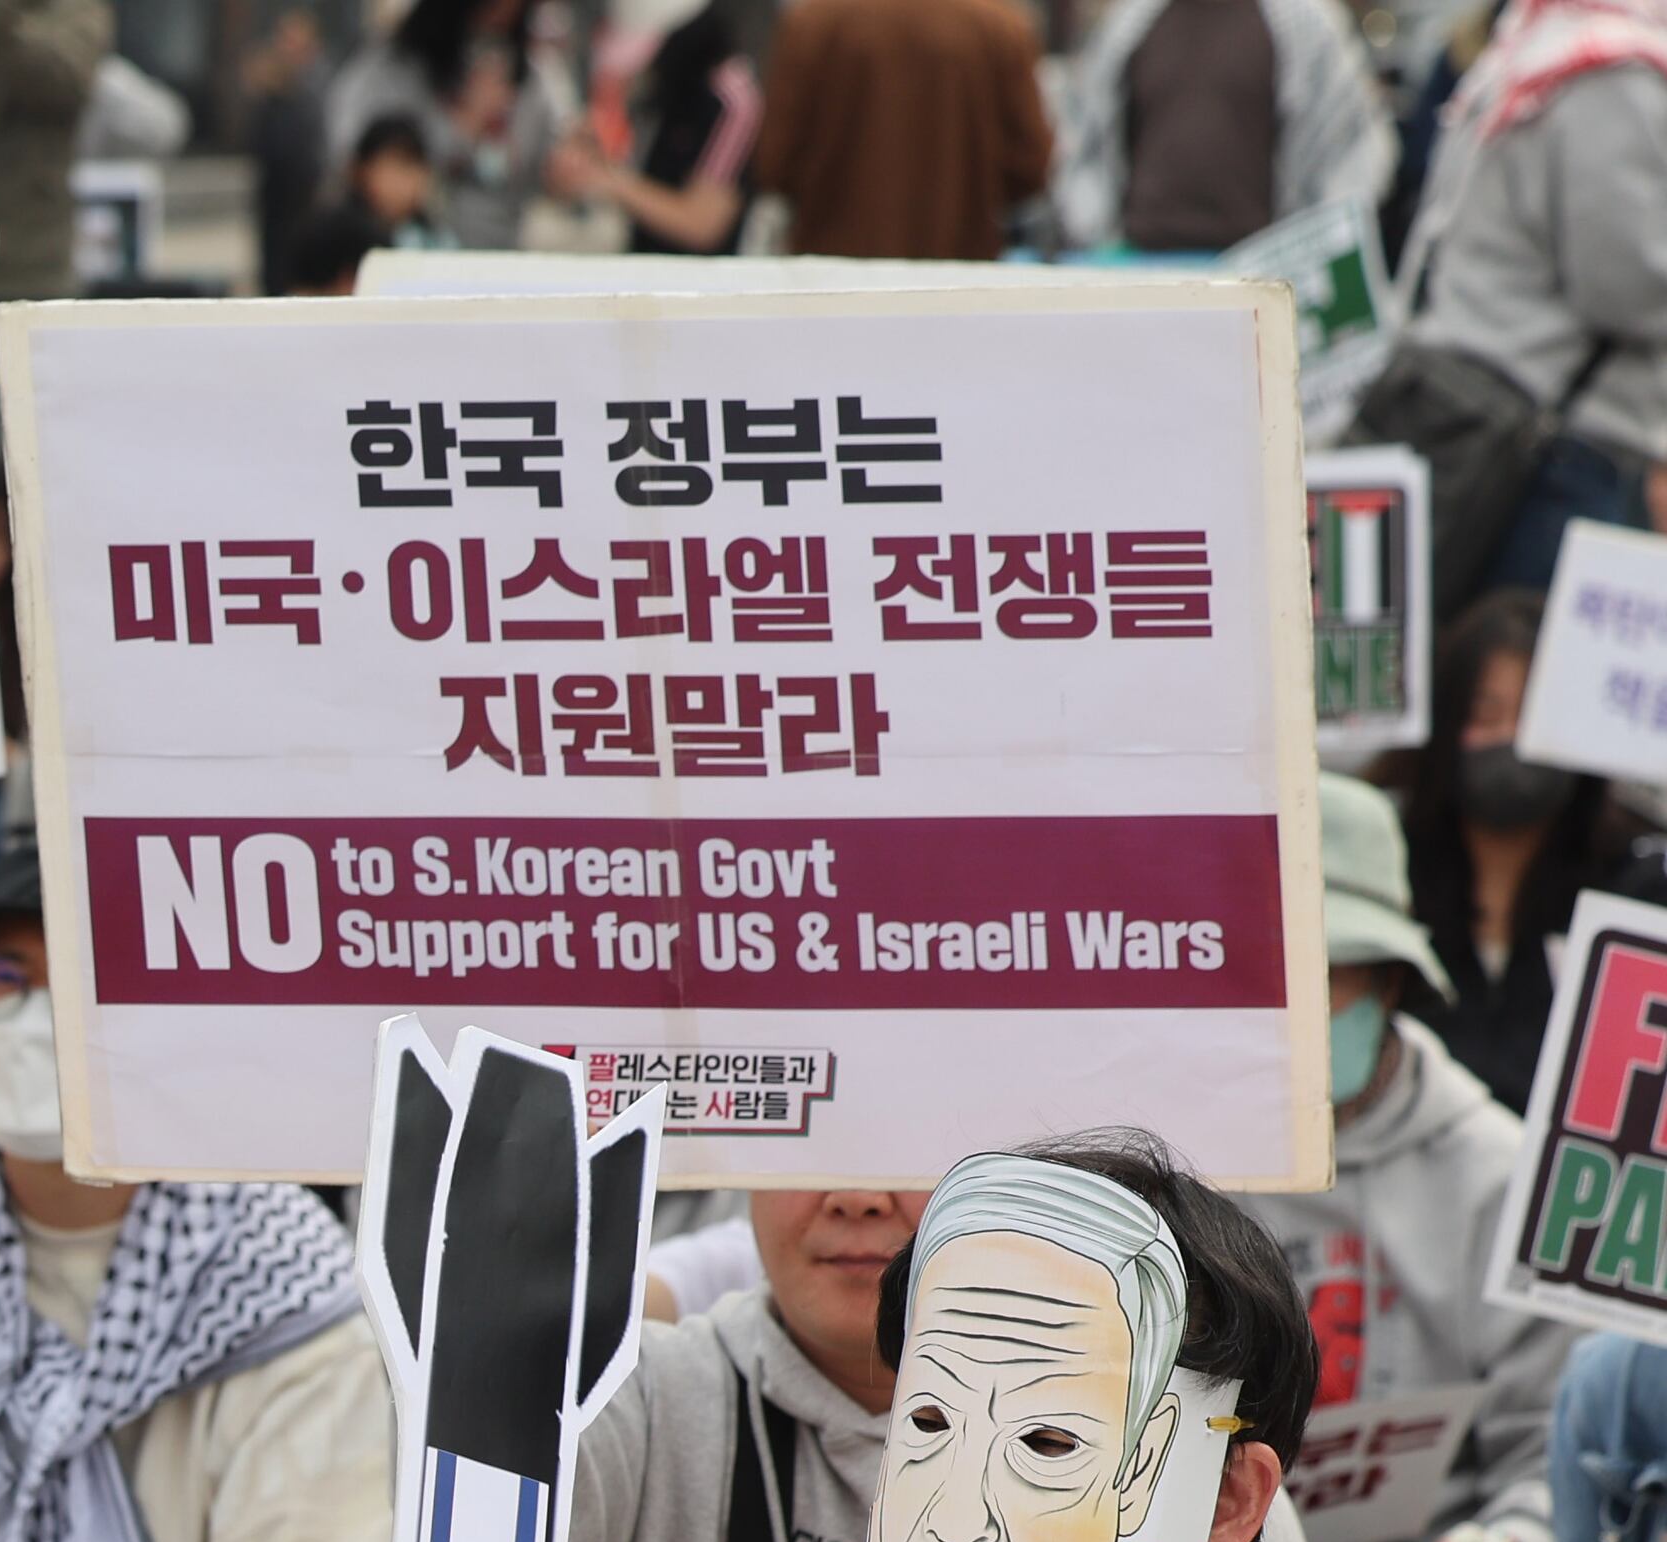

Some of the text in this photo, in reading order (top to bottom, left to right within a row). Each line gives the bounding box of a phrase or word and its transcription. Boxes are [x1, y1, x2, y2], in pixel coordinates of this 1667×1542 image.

[347, 397, 942, 507] 한국 정부는
[108, 531, 1212, 644] 미국·이스라엘 전쟁들
[440, 673, 889, 777] 지원말라
[137, 833, 322, 973] NO
[331, 838, 394, 895] to
[699, 838, 837, 898] Govt
[338, 910, 1224, 976] Support for US & Israeli Wars
[586, 1089, 789, 1120] 연대는 사람들
[589, 1053, 816, 1084] 팔레스타인인들과
